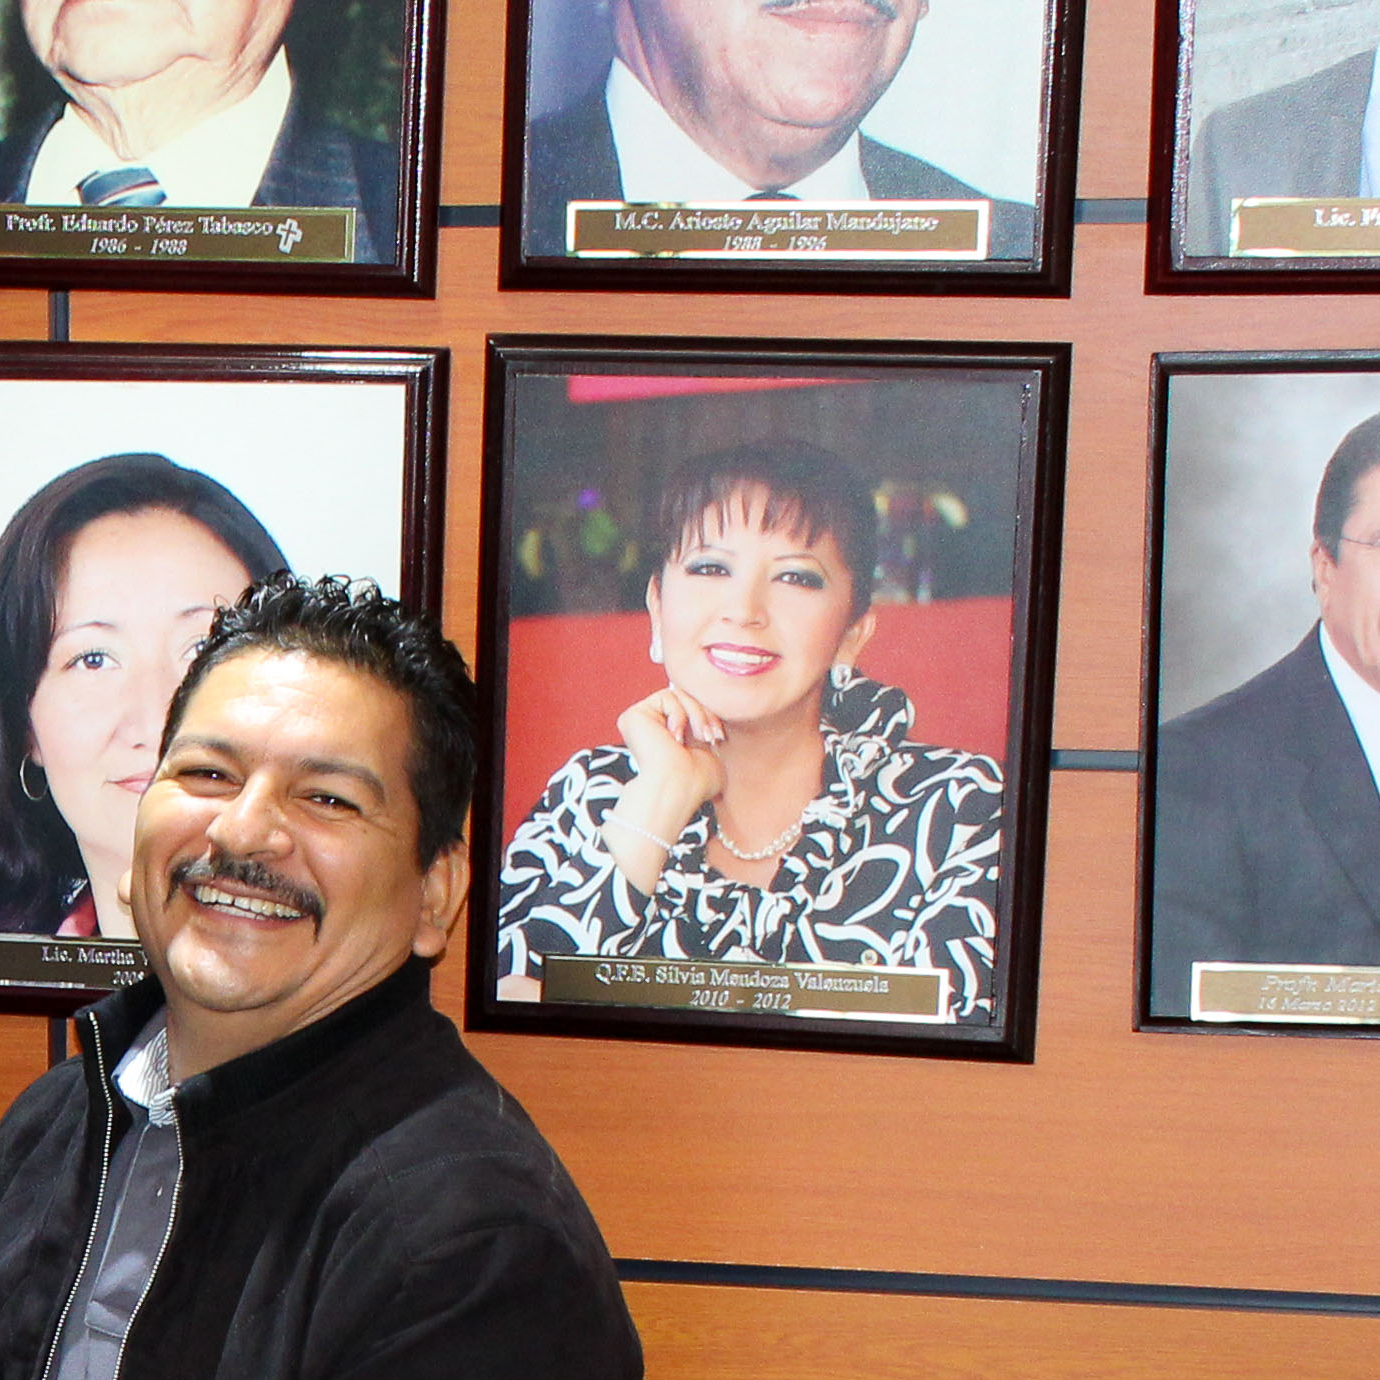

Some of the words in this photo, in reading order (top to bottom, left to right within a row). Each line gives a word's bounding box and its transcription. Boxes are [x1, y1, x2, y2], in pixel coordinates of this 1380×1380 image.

[62, 214, 139, 234] Eduardo
[143, 215, 194, 235] Pérez
[198, 216, 274, 236] Tabasco
[614, 212, 663, 231] M.C.
[746, 212, 821, 234] Aguilar
[826, 213, 939, 236] Mandujano
[1313, 207, 1356, 227] Lic.
[90, 237, 127, 254] 1986
[150, 238, 188, 256] 1988
[41, 945, 73, 962] Lic.
[77, 947, 135, 966] Martha
[655, 966, 705, 986] Silvia
[709, 968, 789, 989] Mendoza
[793, 972, 889, 994] Valenzuela
[689, 990, 729, 1006] 2010
[753, 993, 791, 1010] 2012
